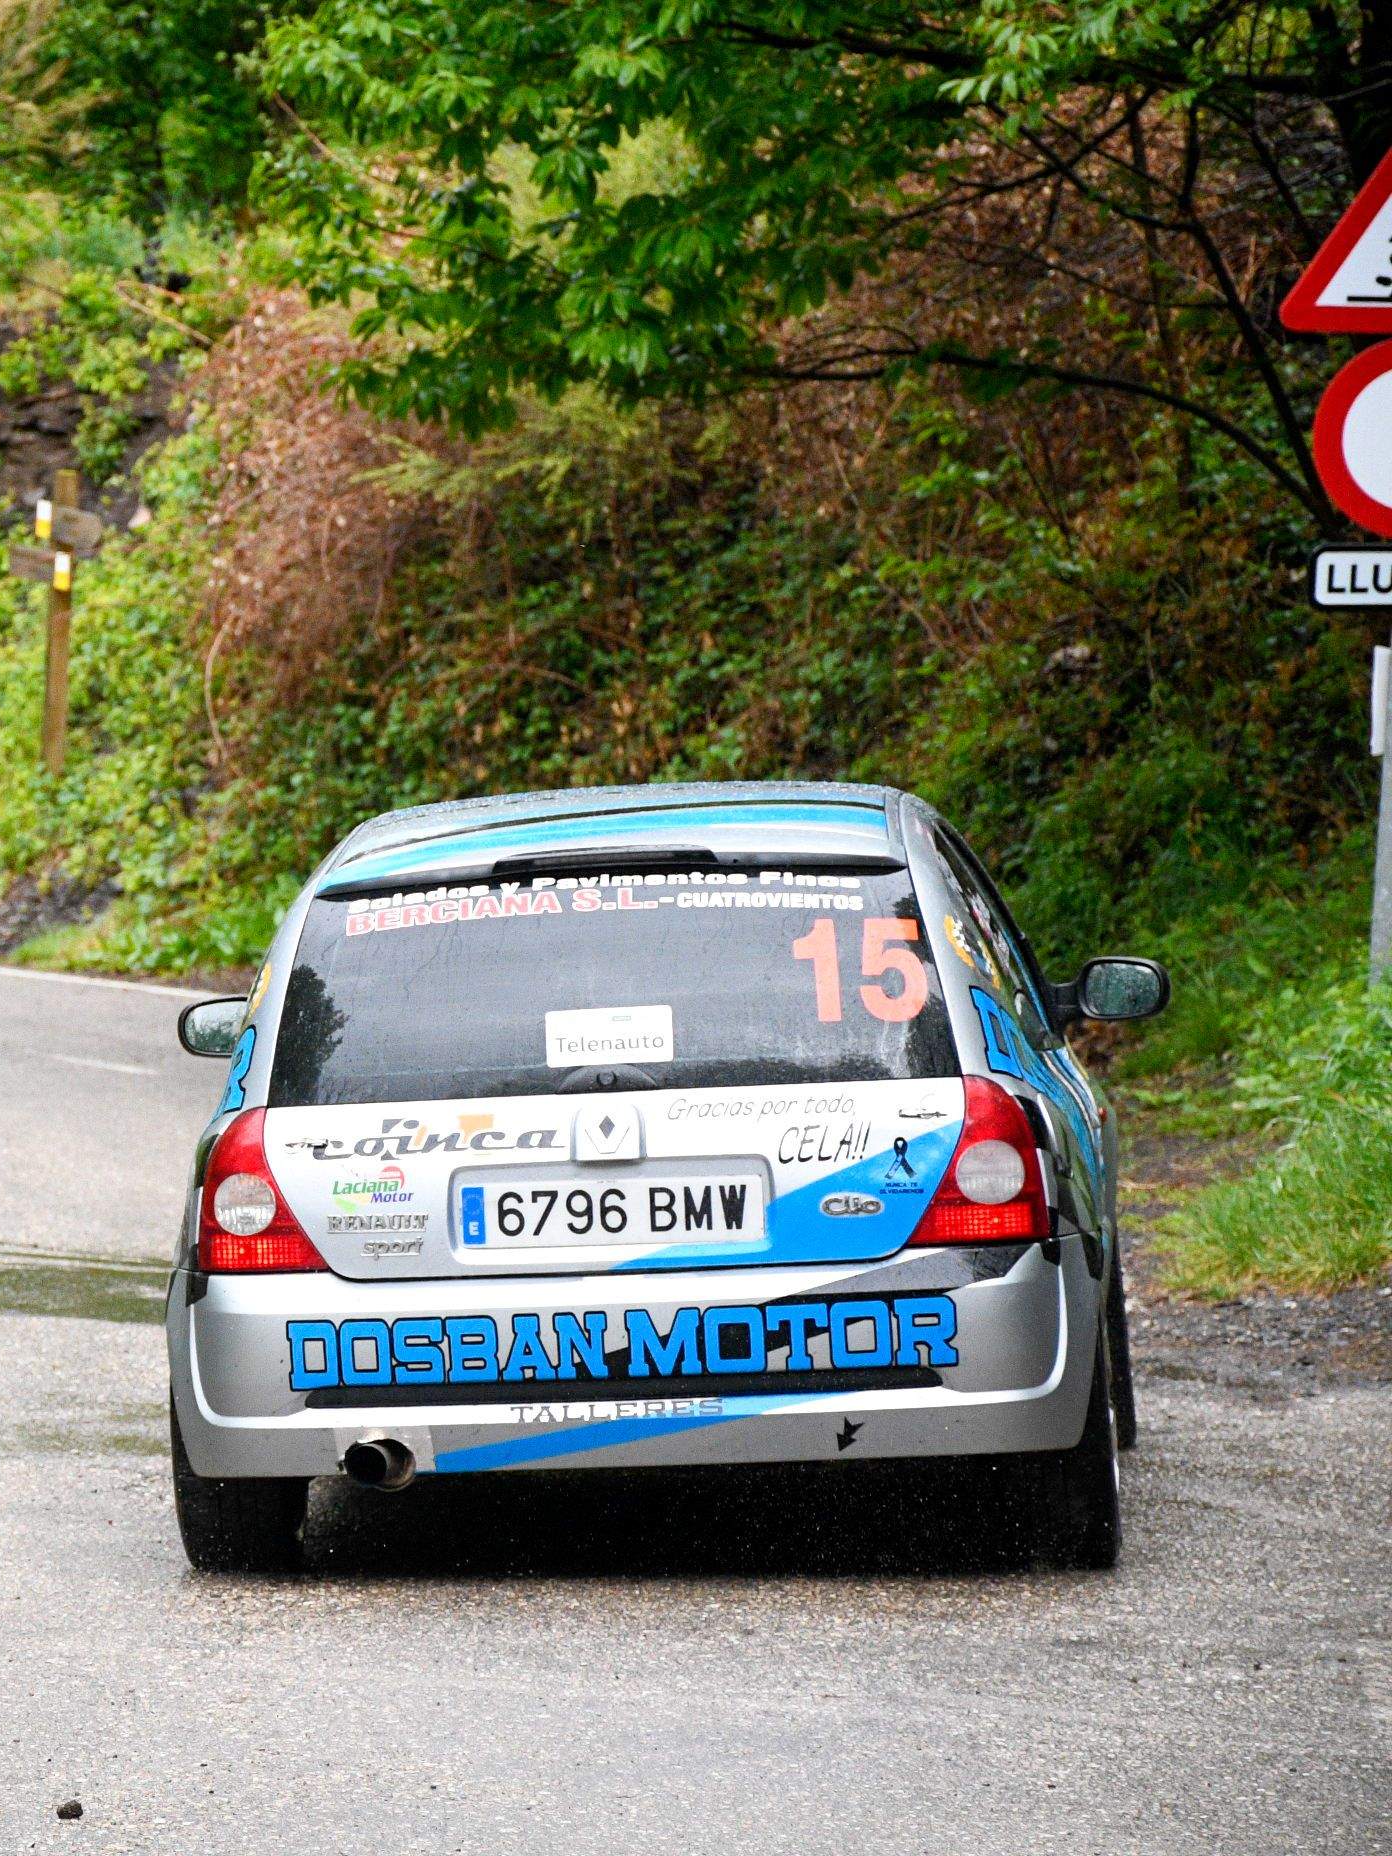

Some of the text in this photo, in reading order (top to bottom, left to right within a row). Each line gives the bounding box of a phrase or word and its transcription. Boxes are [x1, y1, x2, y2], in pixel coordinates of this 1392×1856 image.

[1328, 564, 1392, 593] LLU
[531, 872, 749, 891] Pavimentos
[759, 871, 861, 889] Finos
[346, 891, 563, 937] BERCIANA
[792, 917, 929, 1023] 15
[555, 1035, 665, 1053] Telenauto
[667, 1098, 754, 1121] Gracias
[757, 1098, 798, 1122] por
[777, 1120, 872, 1165] CELA!!
[332, 1179, 400, 1196] Laciana
[371, 1192, 415, 1204] Motor
[497, 1184, 747, 1237] 6796 BMW
[821, 1196, 884, 1216] Clio
[327, 1213, 429, 1232] RENAULT
[468, 1221, 480, 1236] E
[363, 1237, 424, 1260] sport
[286, 1295, 959, 1391] DOSBAN MOTOR
[510, 1398, 725, 1425] TALLERES
